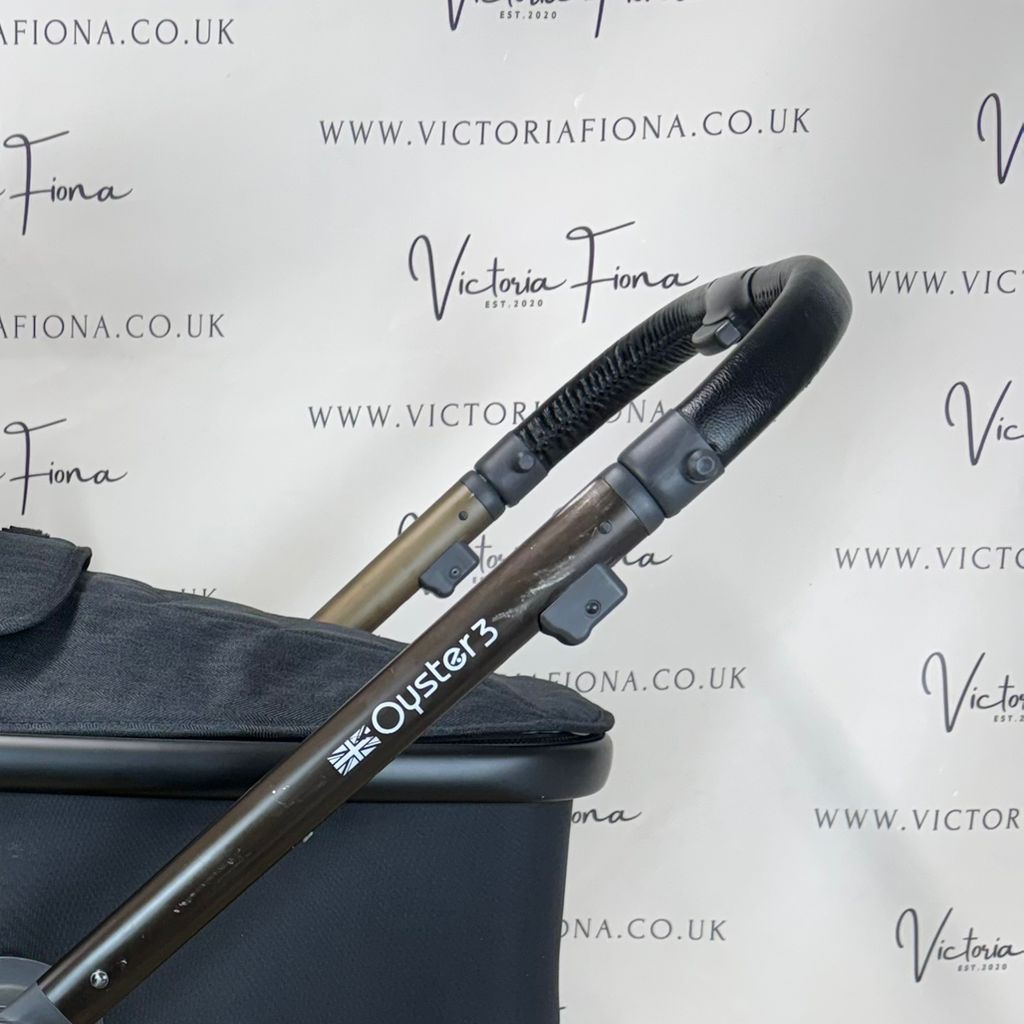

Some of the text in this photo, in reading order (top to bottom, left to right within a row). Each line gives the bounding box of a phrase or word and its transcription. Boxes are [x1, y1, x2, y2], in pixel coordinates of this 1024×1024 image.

[499, 9, 558, 20] EST.2020
[319, 107, 811, 147] WWW.VICTORIAFIONA.CO.UK
[3, 130, 133, 236] Fiona
[408, 221, 699, 324] Victoria Fiona
[484, 296, 544, 309] EST.2020
[3, 418, 128, 516] Fiona
[372, 618, 499, 735] Oyster 3
[895, 907, 1024, 984] Victoria
